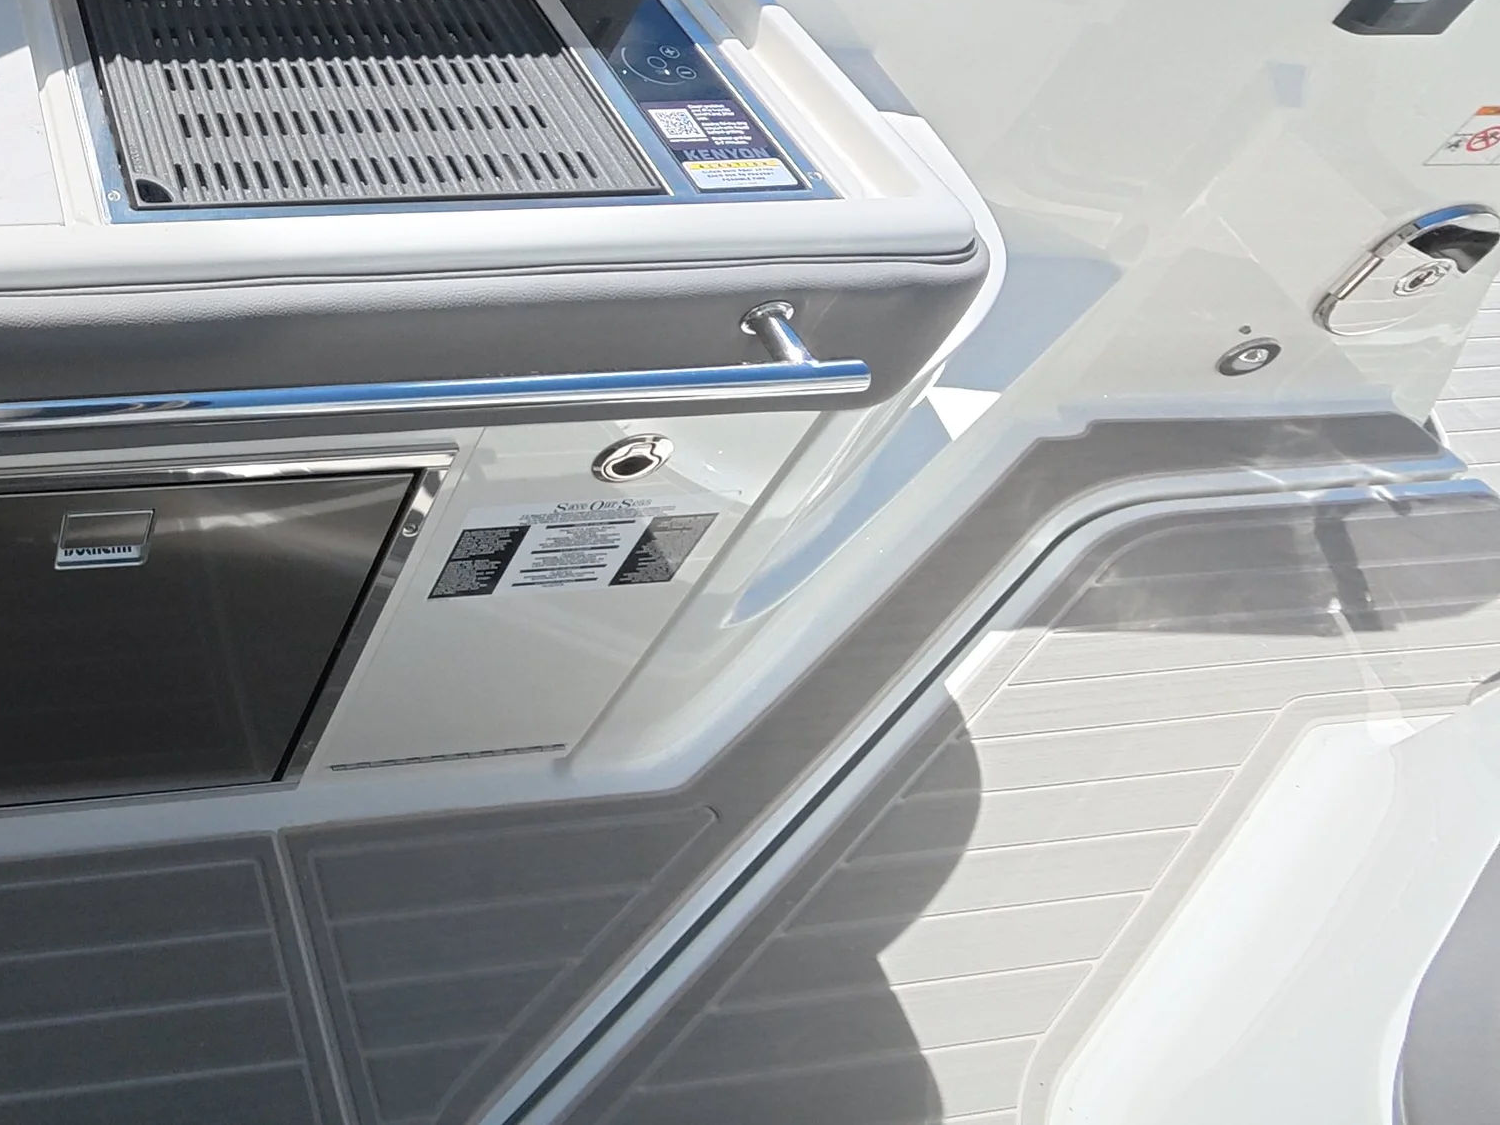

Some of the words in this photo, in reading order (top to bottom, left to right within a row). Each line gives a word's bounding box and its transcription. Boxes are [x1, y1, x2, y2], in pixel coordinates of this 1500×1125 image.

[683, 147, 771, 161] KENYON
[554, 502, 588, 513] Save
[589, 500, 618, 512] Our
